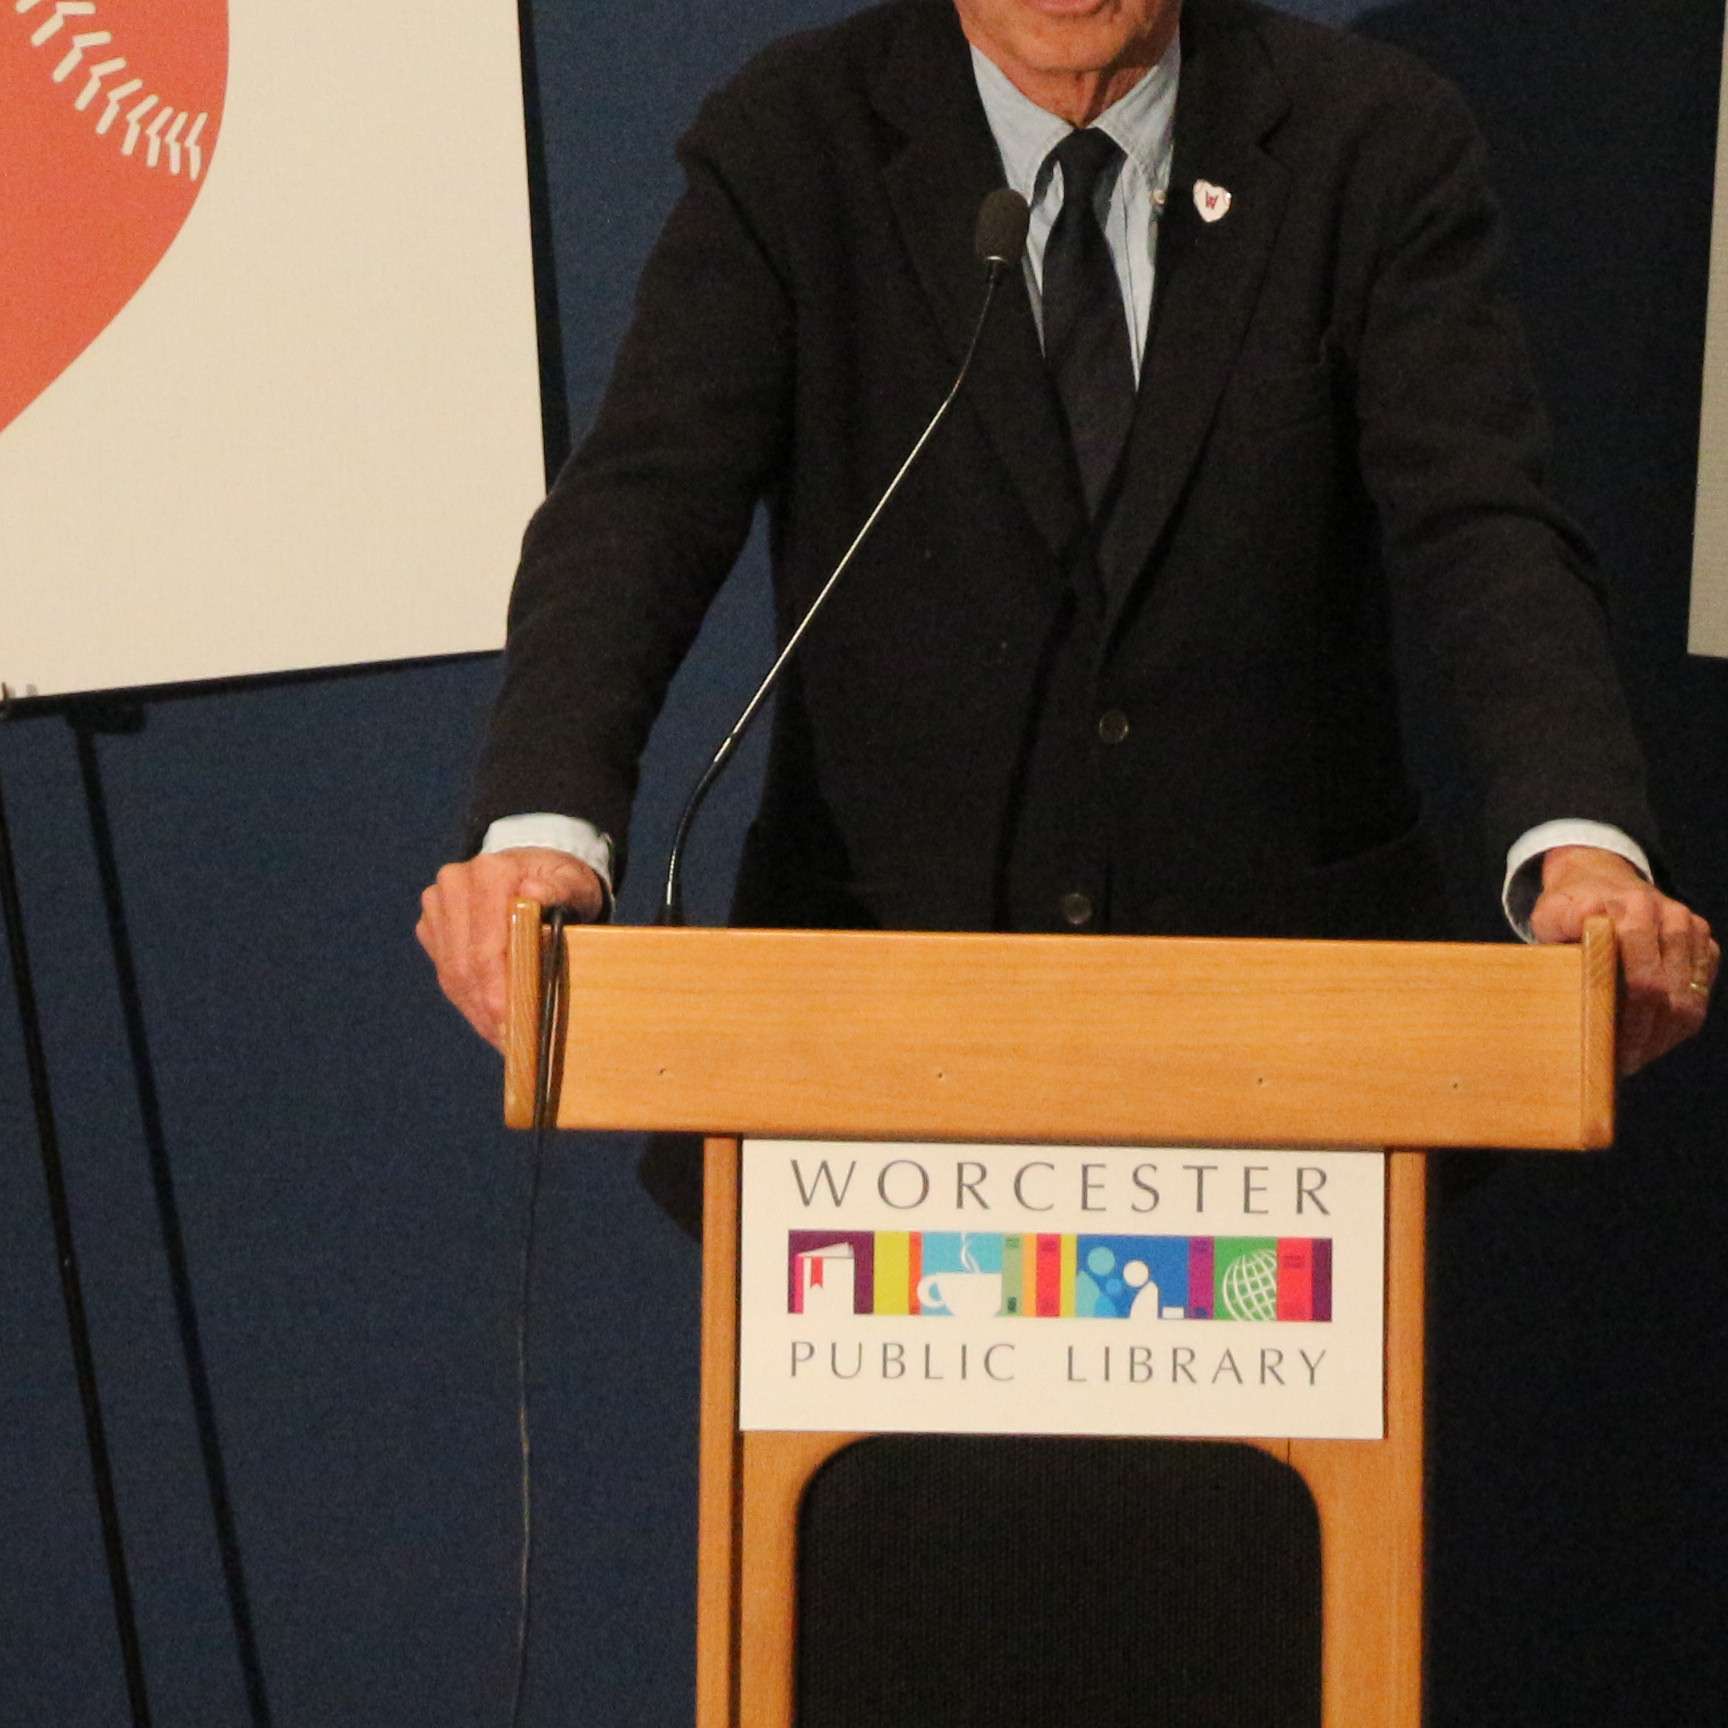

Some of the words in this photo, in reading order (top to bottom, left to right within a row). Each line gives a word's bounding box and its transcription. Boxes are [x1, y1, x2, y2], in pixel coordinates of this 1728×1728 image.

[789, 1158, 1333, 1218] WORCESTER
[790, 1340, 1016, 1382] PUBLIC
[1065, 1343, 1328, 1387] LIBRARY
